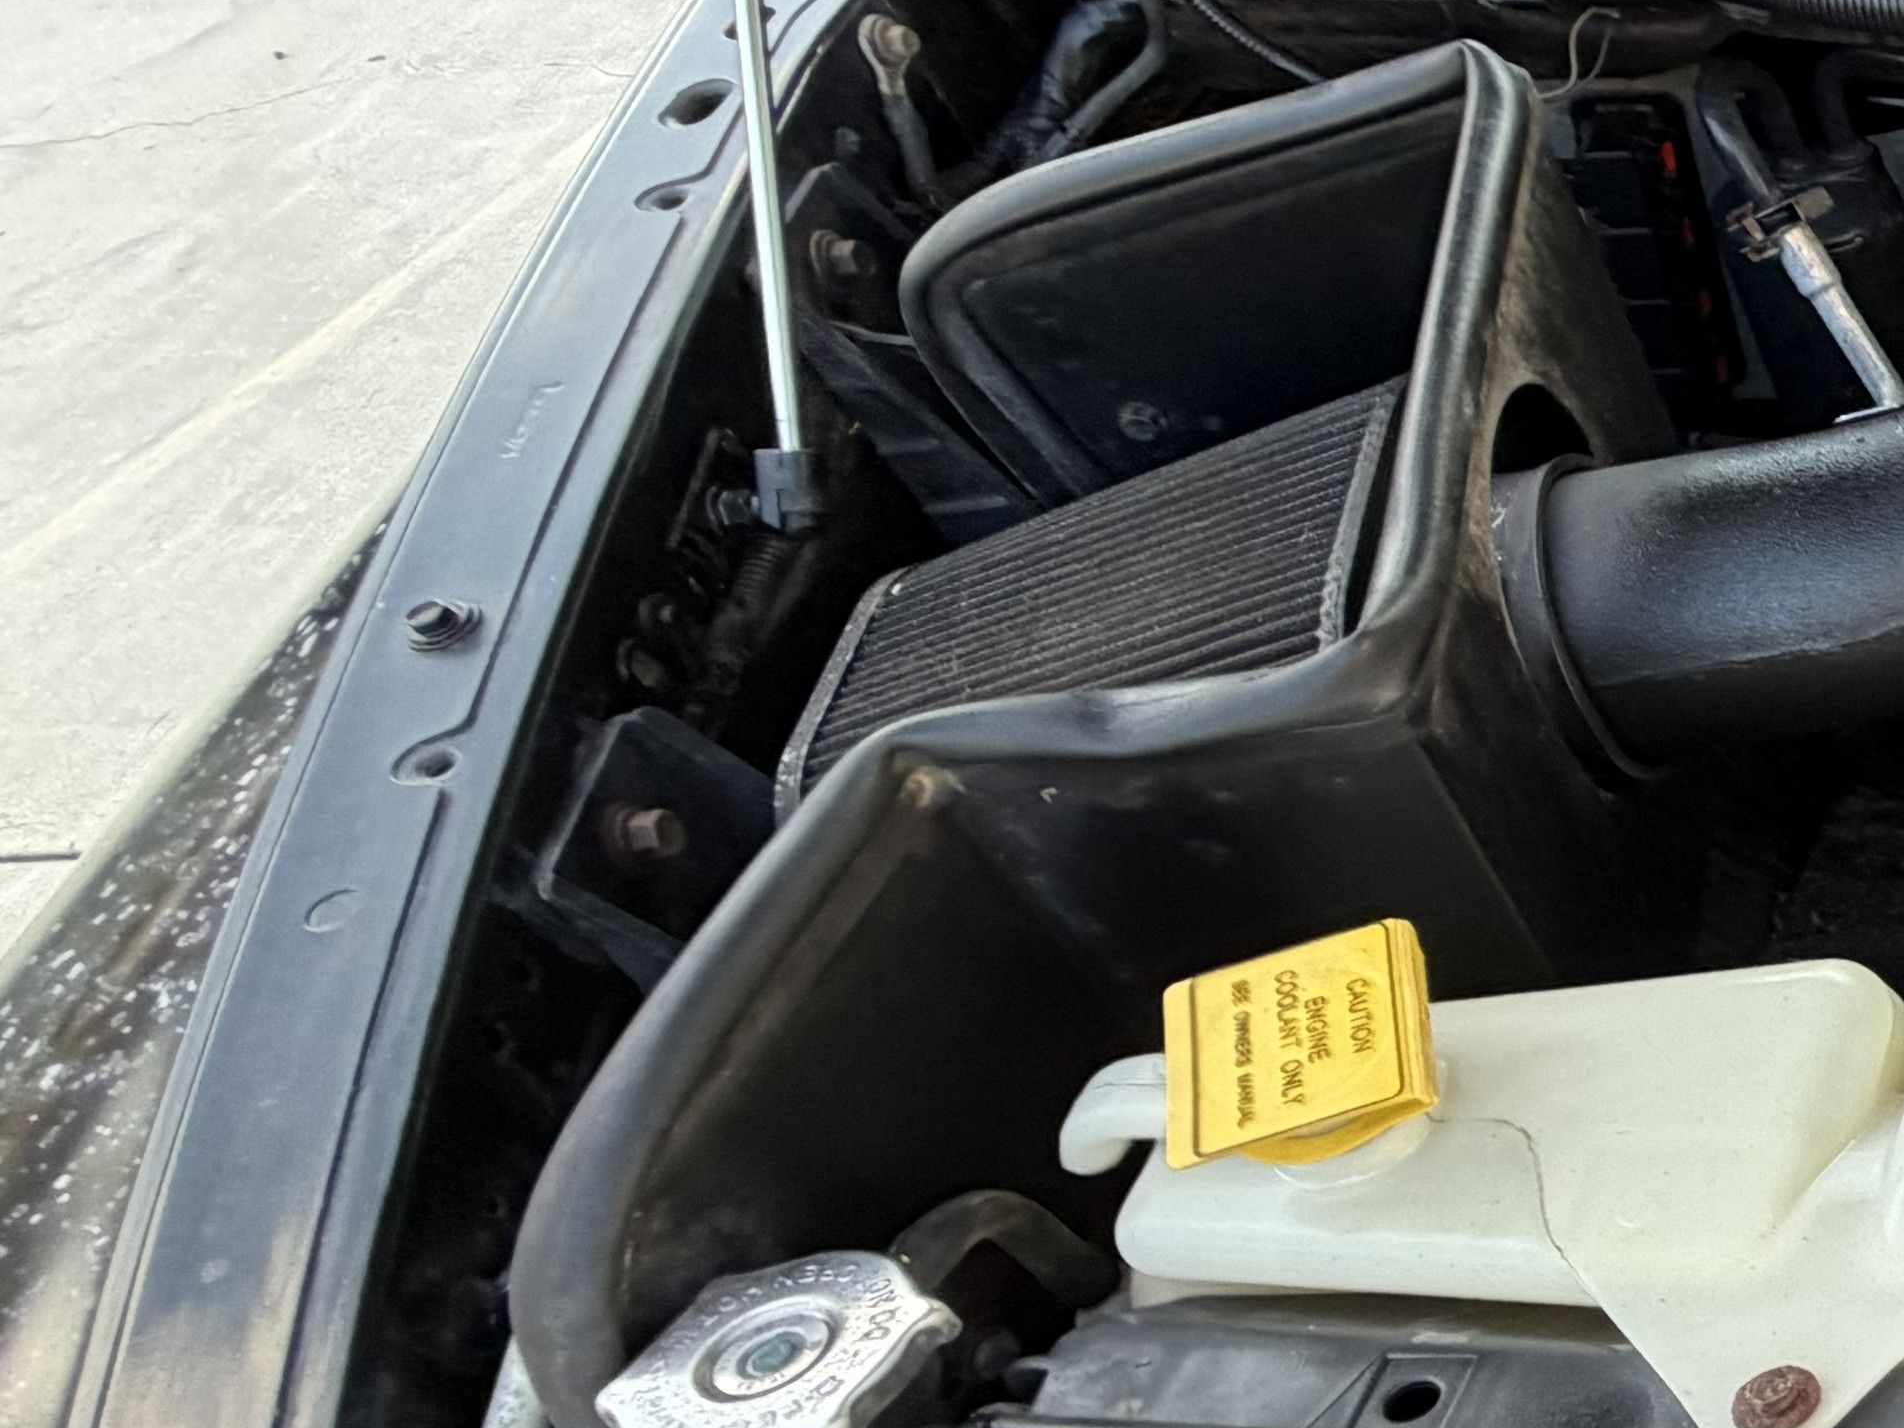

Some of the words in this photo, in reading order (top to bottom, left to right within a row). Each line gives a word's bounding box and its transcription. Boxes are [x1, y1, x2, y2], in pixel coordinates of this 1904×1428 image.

[1274, 969, 1304, 1049] COOLANT
[1303, 995, 1332, 1065] ENGINE
[1346, 976, 1375, 1054] CAUTION
[1279, 1059, 1306, 1106] ONLY
